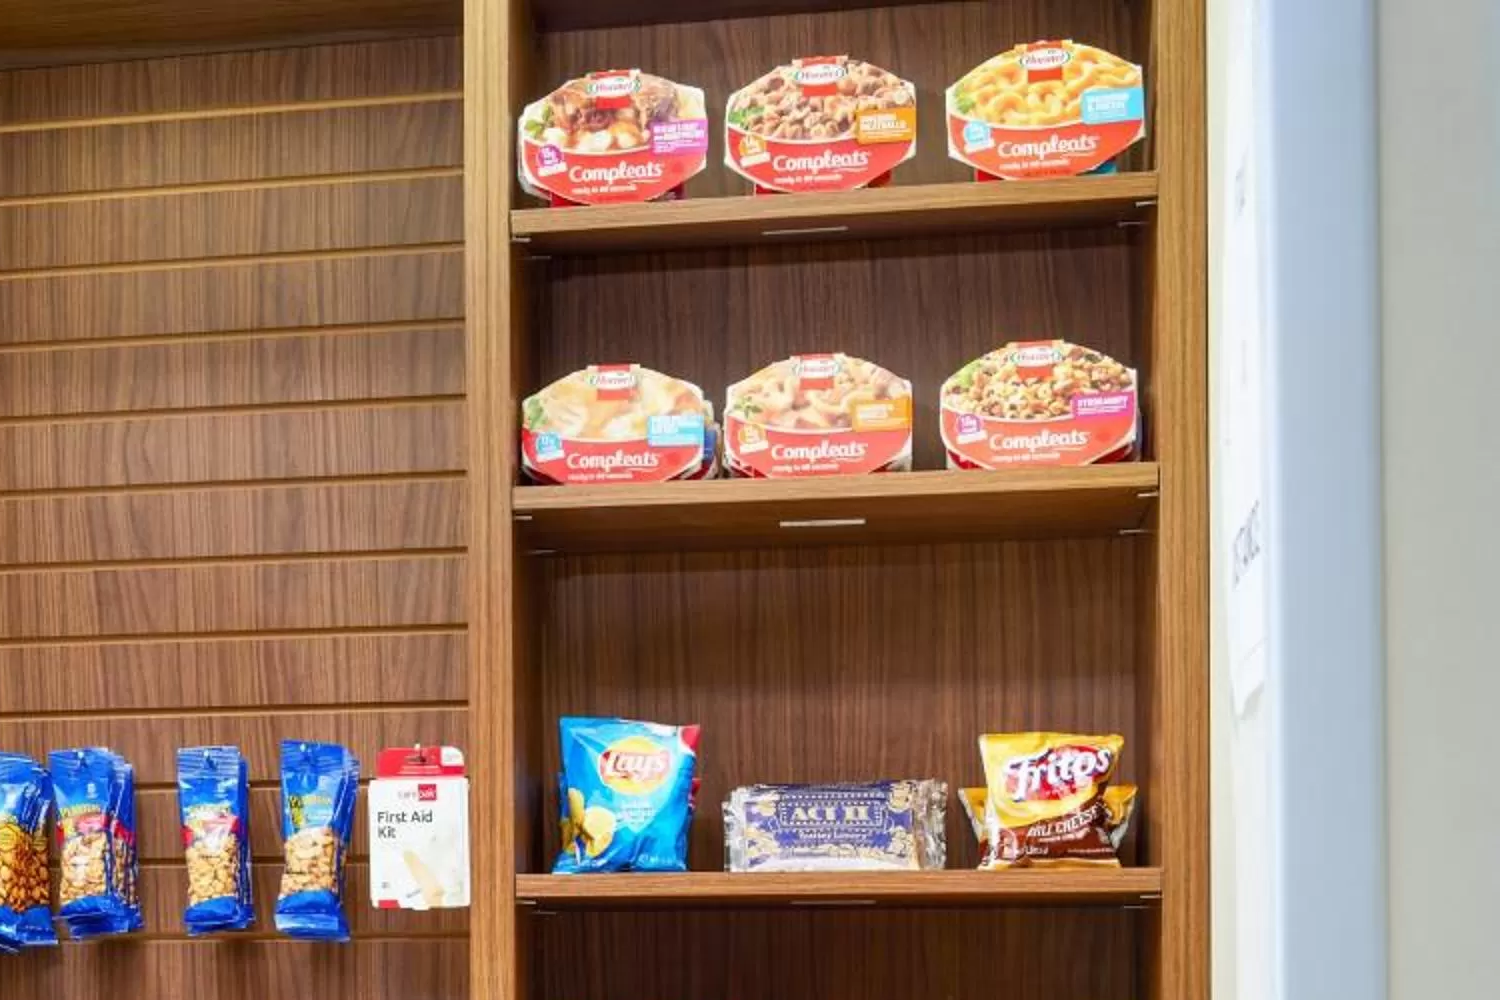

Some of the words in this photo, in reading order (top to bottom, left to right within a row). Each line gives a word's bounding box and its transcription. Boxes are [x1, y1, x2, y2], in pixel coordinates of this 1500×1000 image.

[998, 135, 1097, 160] Compleats
[569, 160, 663, 185] Compleats
[773, 150, 868, 175] Compleats
[771, 439, 866, 464] Compleats
[989, 428, 1089, 452] Compleats
[567, 449, 660, 472] Compleats
[1003, 749, 1112, 802] Fritos
[377, 811, 407, 823] First
[411, 811, 433, 823] Aid
[791, 806, 836, 822] ACT
[845, 806, 870, 821] II
[378, 826, 396, 839] Kit
